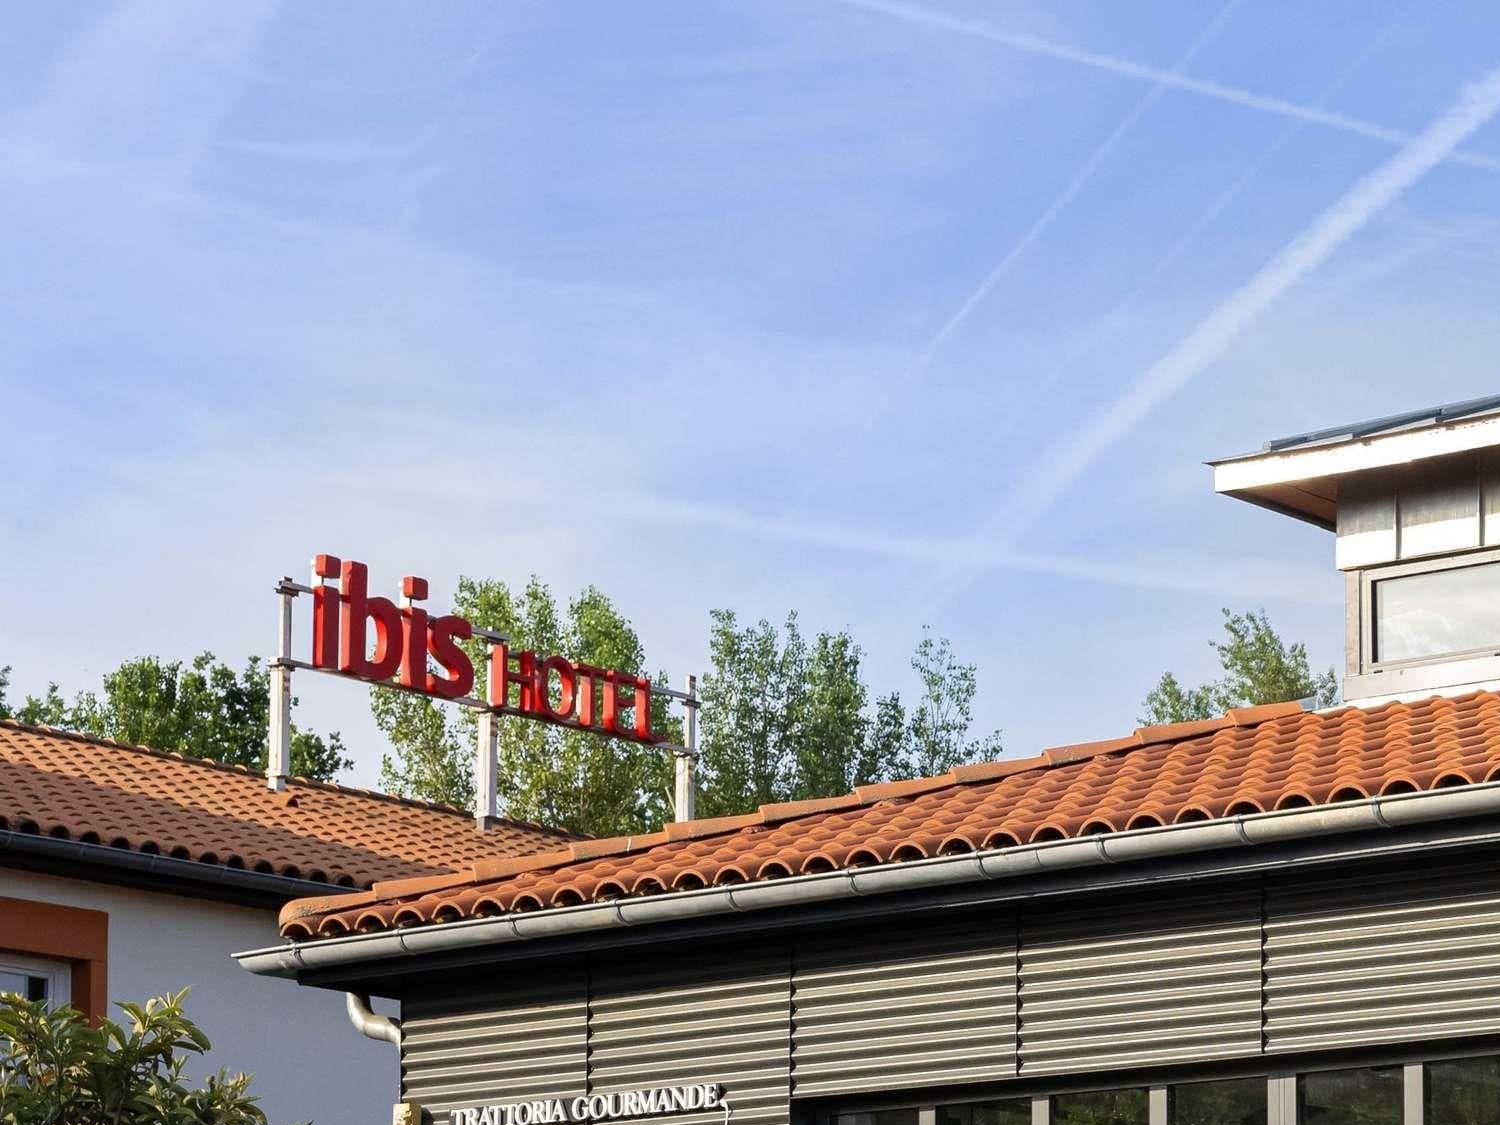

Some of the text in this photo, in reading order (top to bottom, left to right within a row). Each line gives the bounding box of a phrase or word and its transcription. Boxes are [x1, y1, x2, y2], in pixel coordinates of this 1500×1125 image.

[312, 554, 669, 744] ibis HOTEL
[570, 1083, 722, 1121] GOURMANDE
